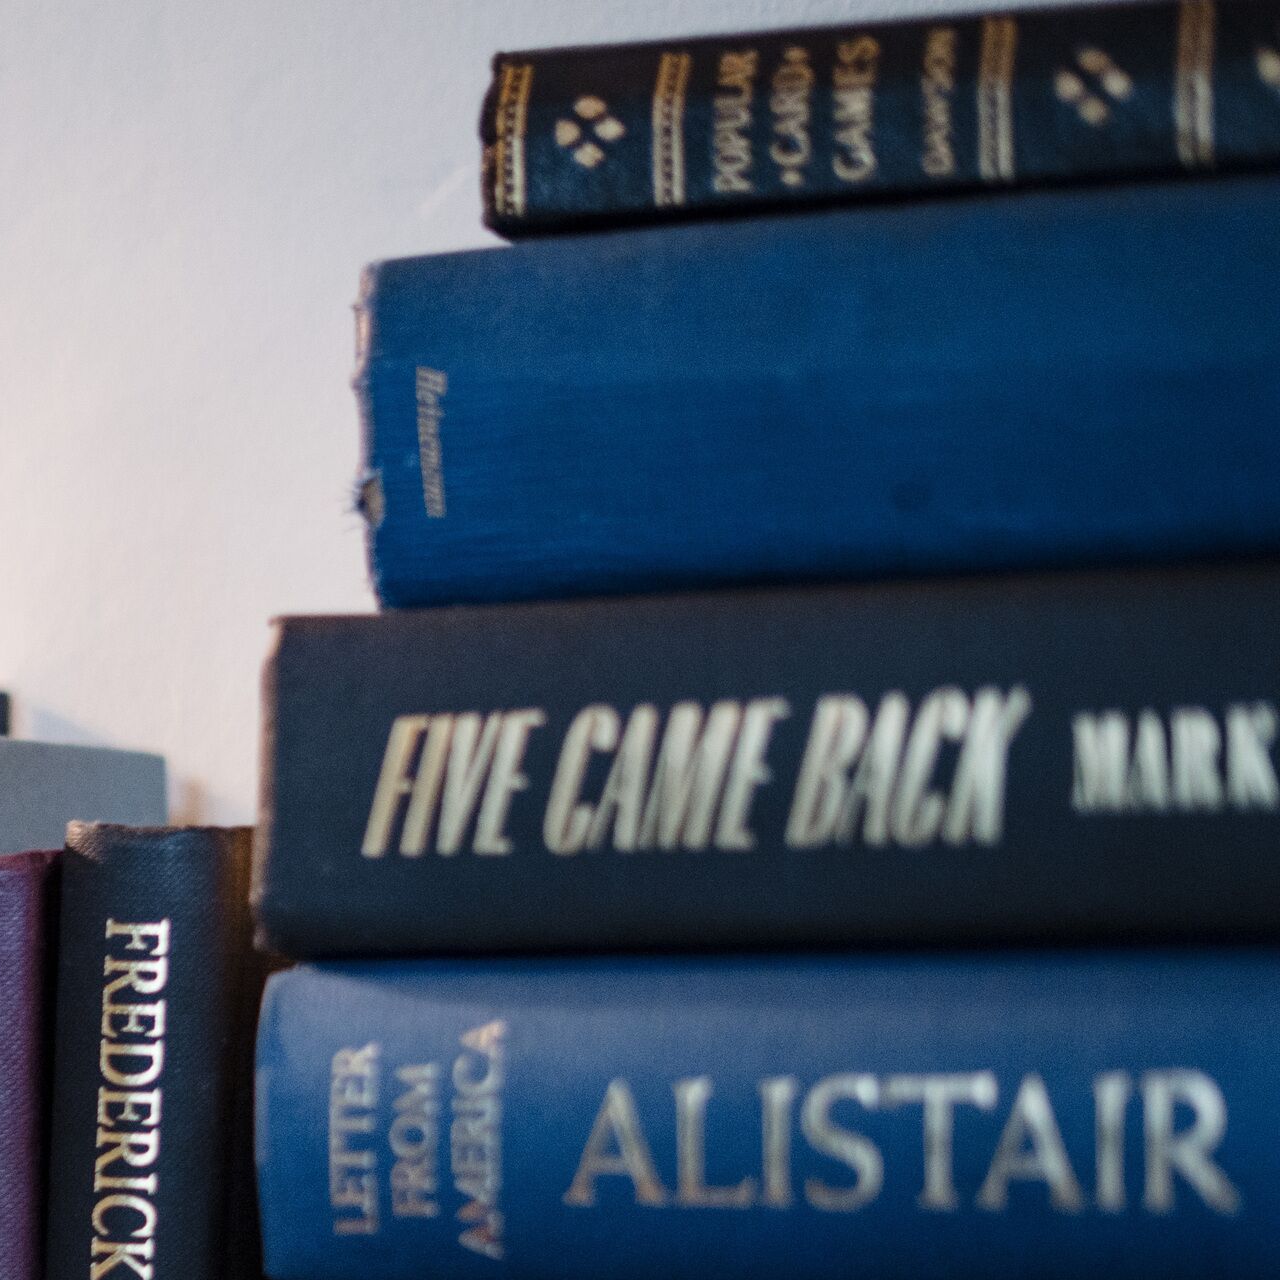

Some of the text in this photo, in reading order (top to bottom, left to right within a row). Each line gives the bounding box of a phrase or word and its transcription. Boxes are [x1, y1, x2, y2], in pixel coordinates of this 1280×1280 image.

[361, 684, 1280, 859] FIVE CAME BACK MARK
[329, 1040, 381, 1236] LETTER
[388, 1060, 438, 1218] FROM
[451, 1016, 508, 1261] AMERICA
[562, 1069, 1240, 1214] ALISTAIR
